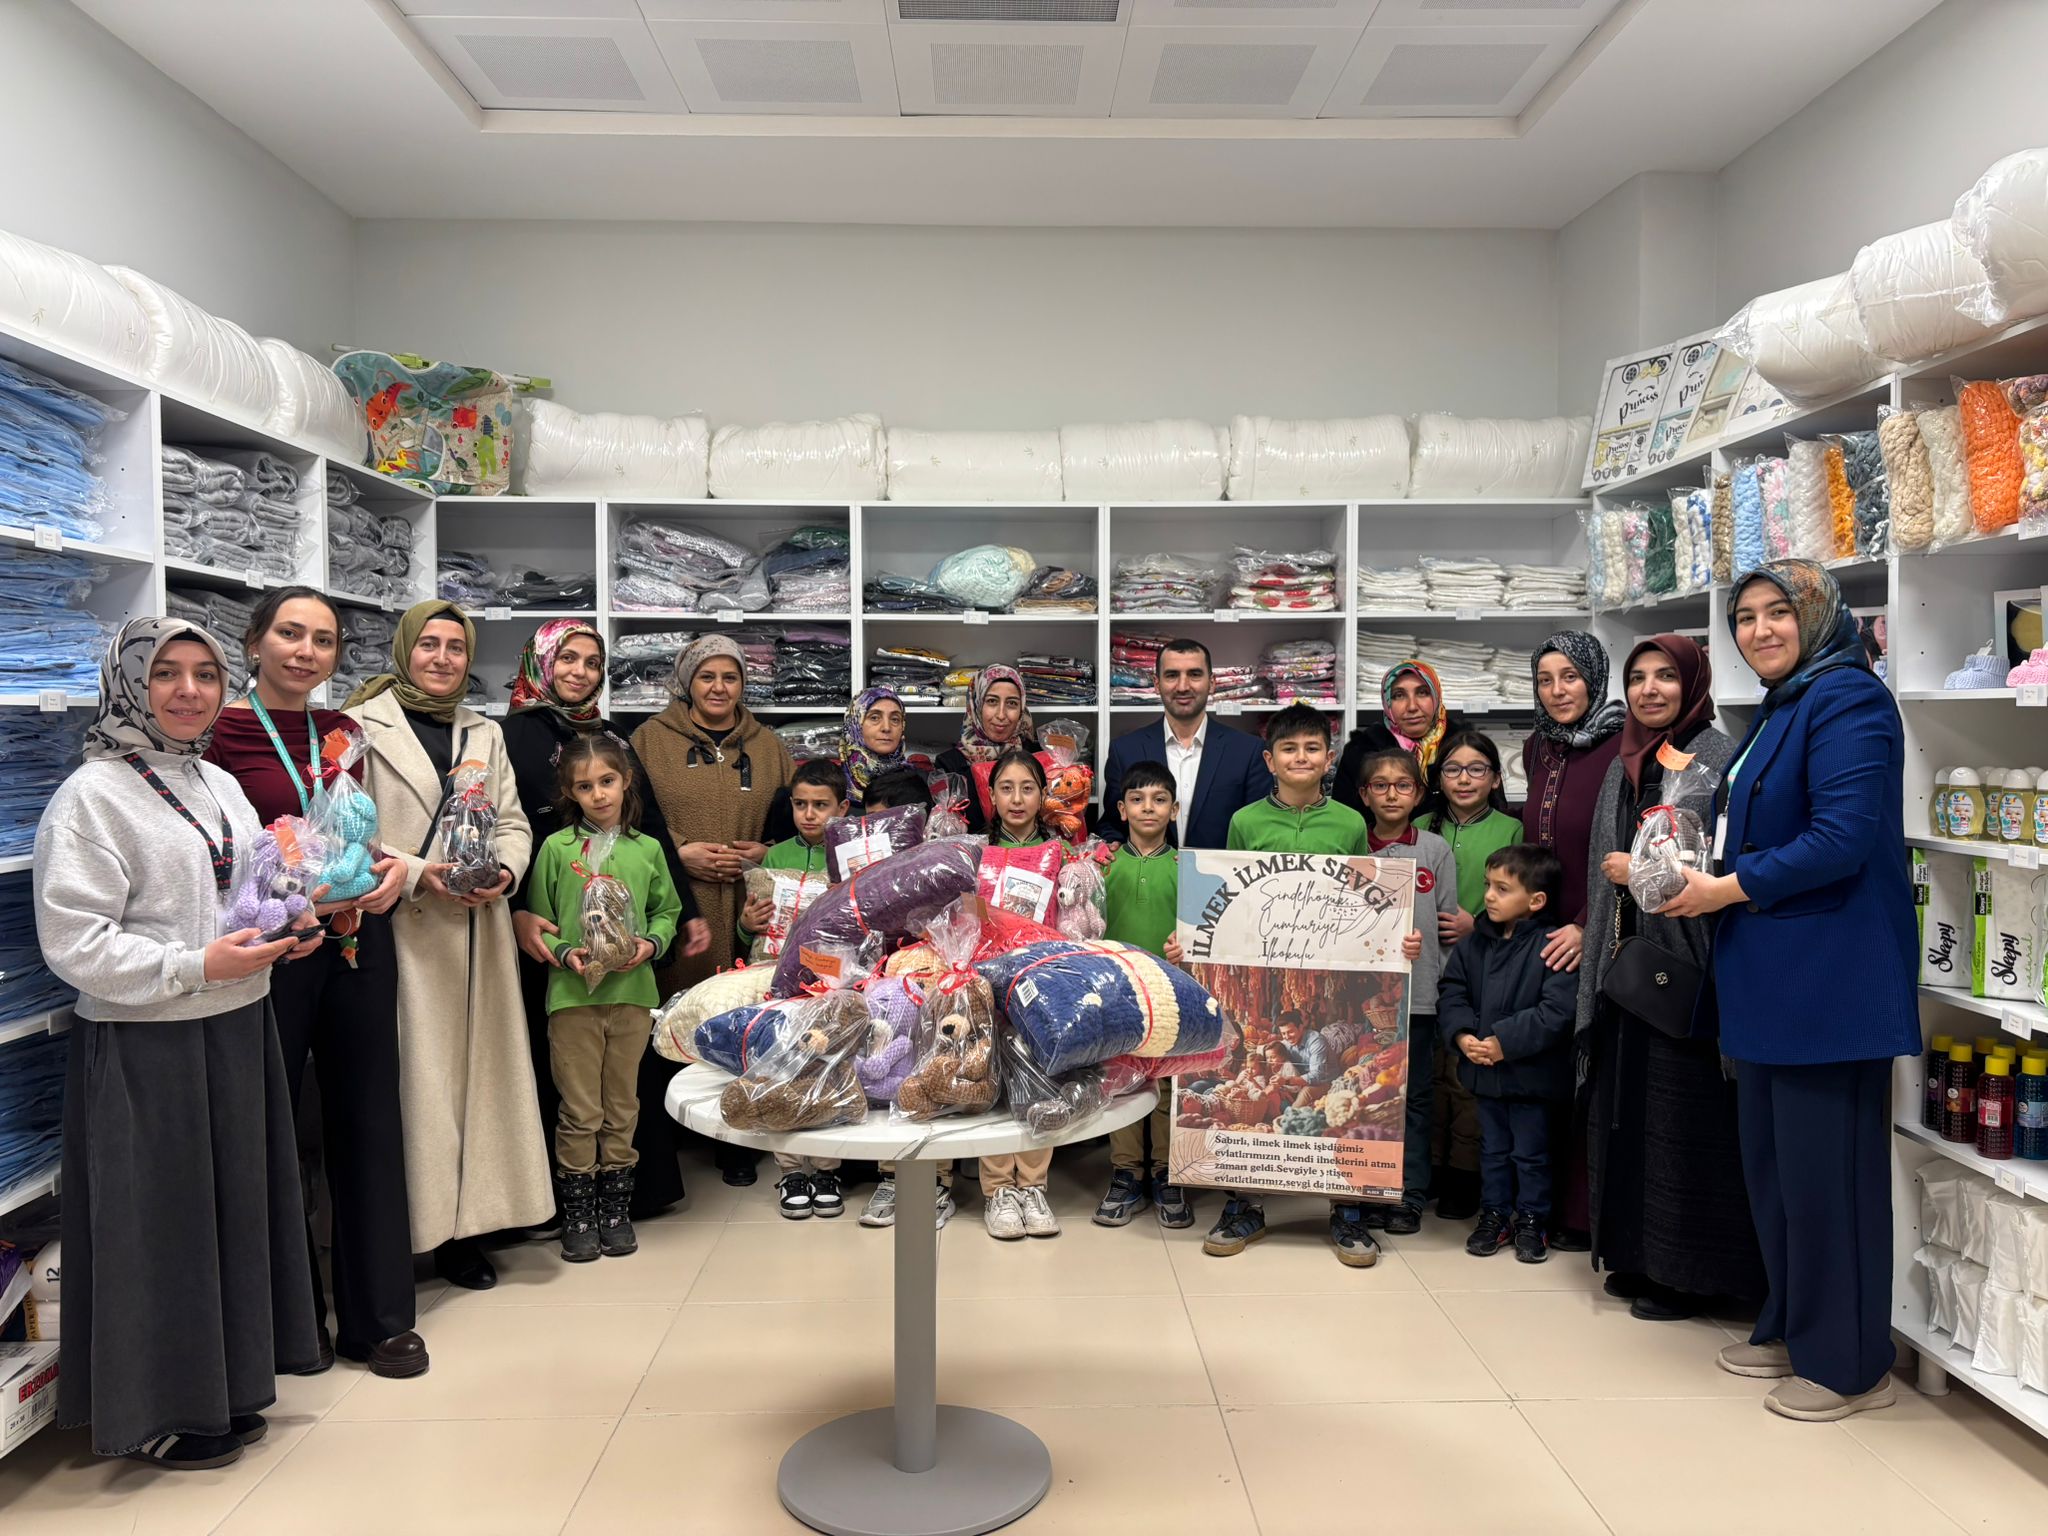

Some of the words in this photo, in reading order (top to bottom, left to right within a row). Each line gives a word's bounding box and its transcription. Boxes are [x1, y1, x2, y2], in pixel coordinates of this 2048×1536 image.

[1187, 882, 1239, 957] İLMEK
[1233, 853, 1316, 889] İLMEK
[1322, 857, 1397, 915] SEVGİ
[1259, 908, 1346, 949] Cumhuriyet
[1928, 922, 1957, 972] Sleepy
[1258, 936, 1315, 967] İlkokulu
[1991, 932, 2022, 985] Sleepy
[1252, 1138, 1280, 1148] ilmek
[1283, 1140, 1311, 1150] ilmek
[46, 1267, 60, 1284] 12
